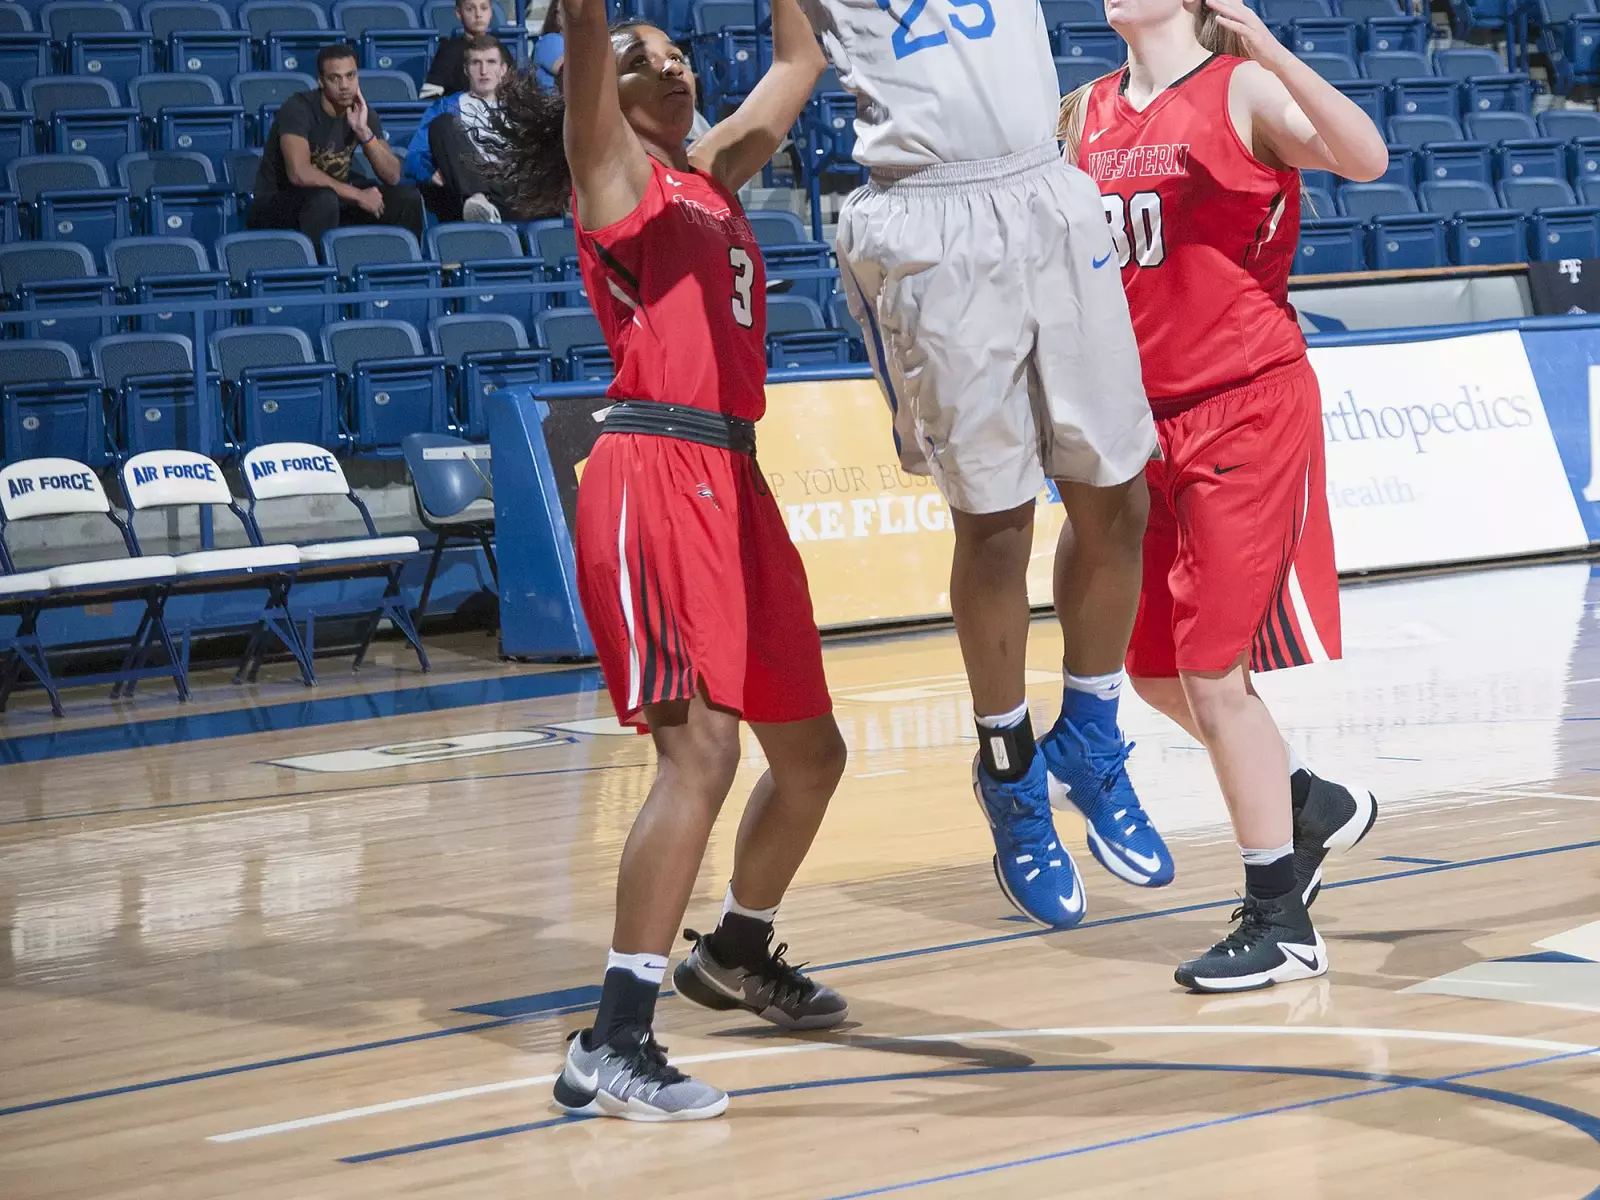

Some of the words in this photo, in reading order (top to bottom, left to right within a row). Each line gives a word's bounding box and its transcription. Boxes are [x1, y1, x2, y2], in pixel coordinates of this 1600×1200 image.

[1088, 143, 1190, 181] WESTERN
[728, 246, 755, 329] 3
[132, 466, 158, 486] AIR
[163, 463, 217, 482] FORCE
[251, 459, 278, 480] AIR
[282, 455, 337, 474] FORCE
[794, 466, 871, 495] YOUR
[7, 477, 35, 499] AIR
[39, 472, 95, 492] FORCE
[850, 492, 955, 537] FLIG
